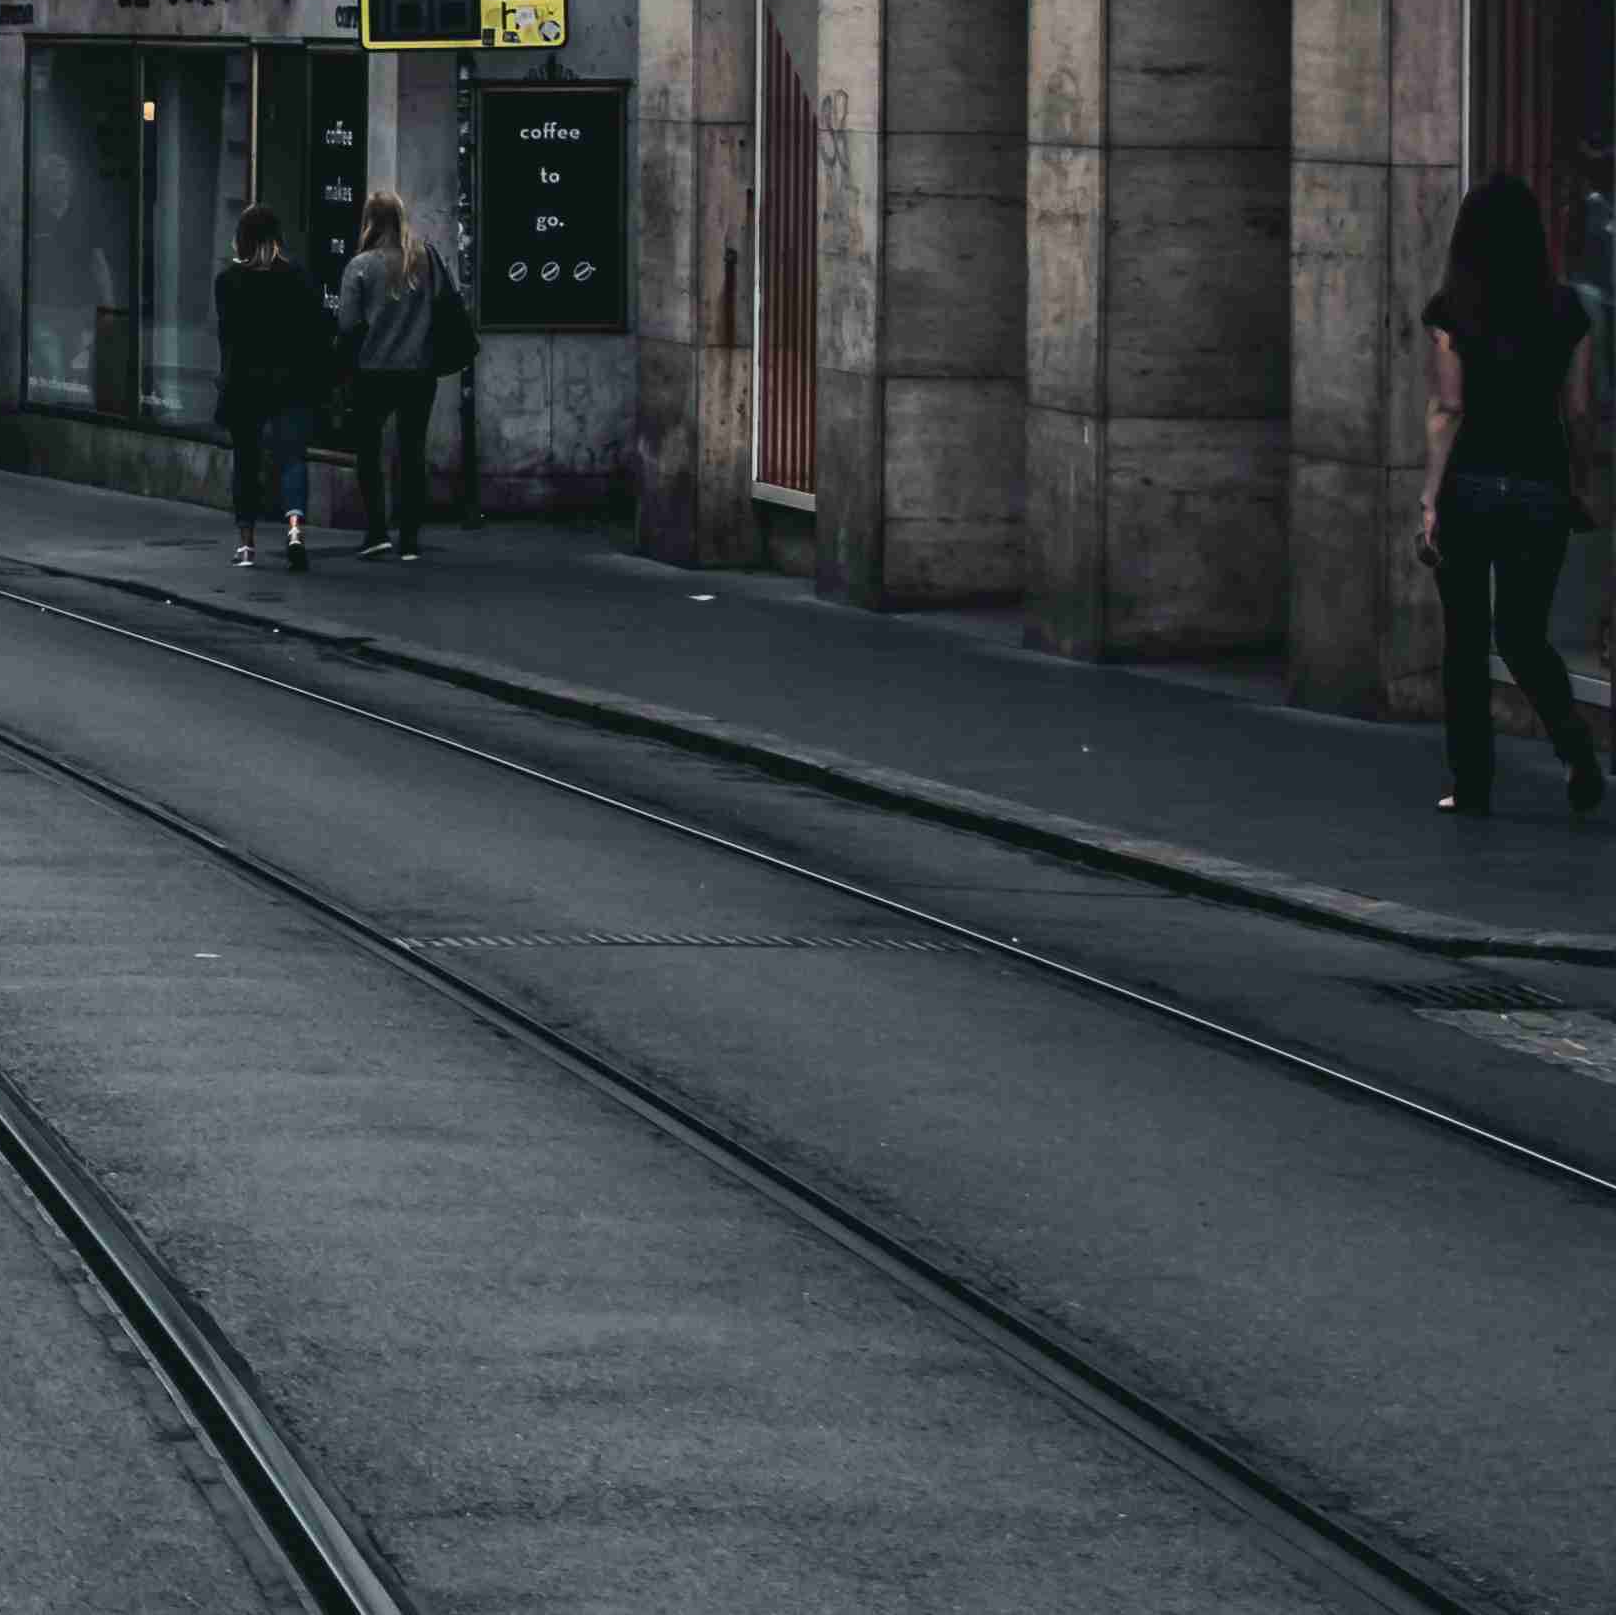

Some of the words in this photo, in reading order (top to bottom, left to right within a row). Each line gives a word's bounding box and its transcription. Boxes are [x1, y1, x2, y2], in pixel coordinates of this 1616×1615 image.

[520, 121, 581, 140] coffee
[540, 167, 560, 183] to
[536, 215, 565, 232] go.
